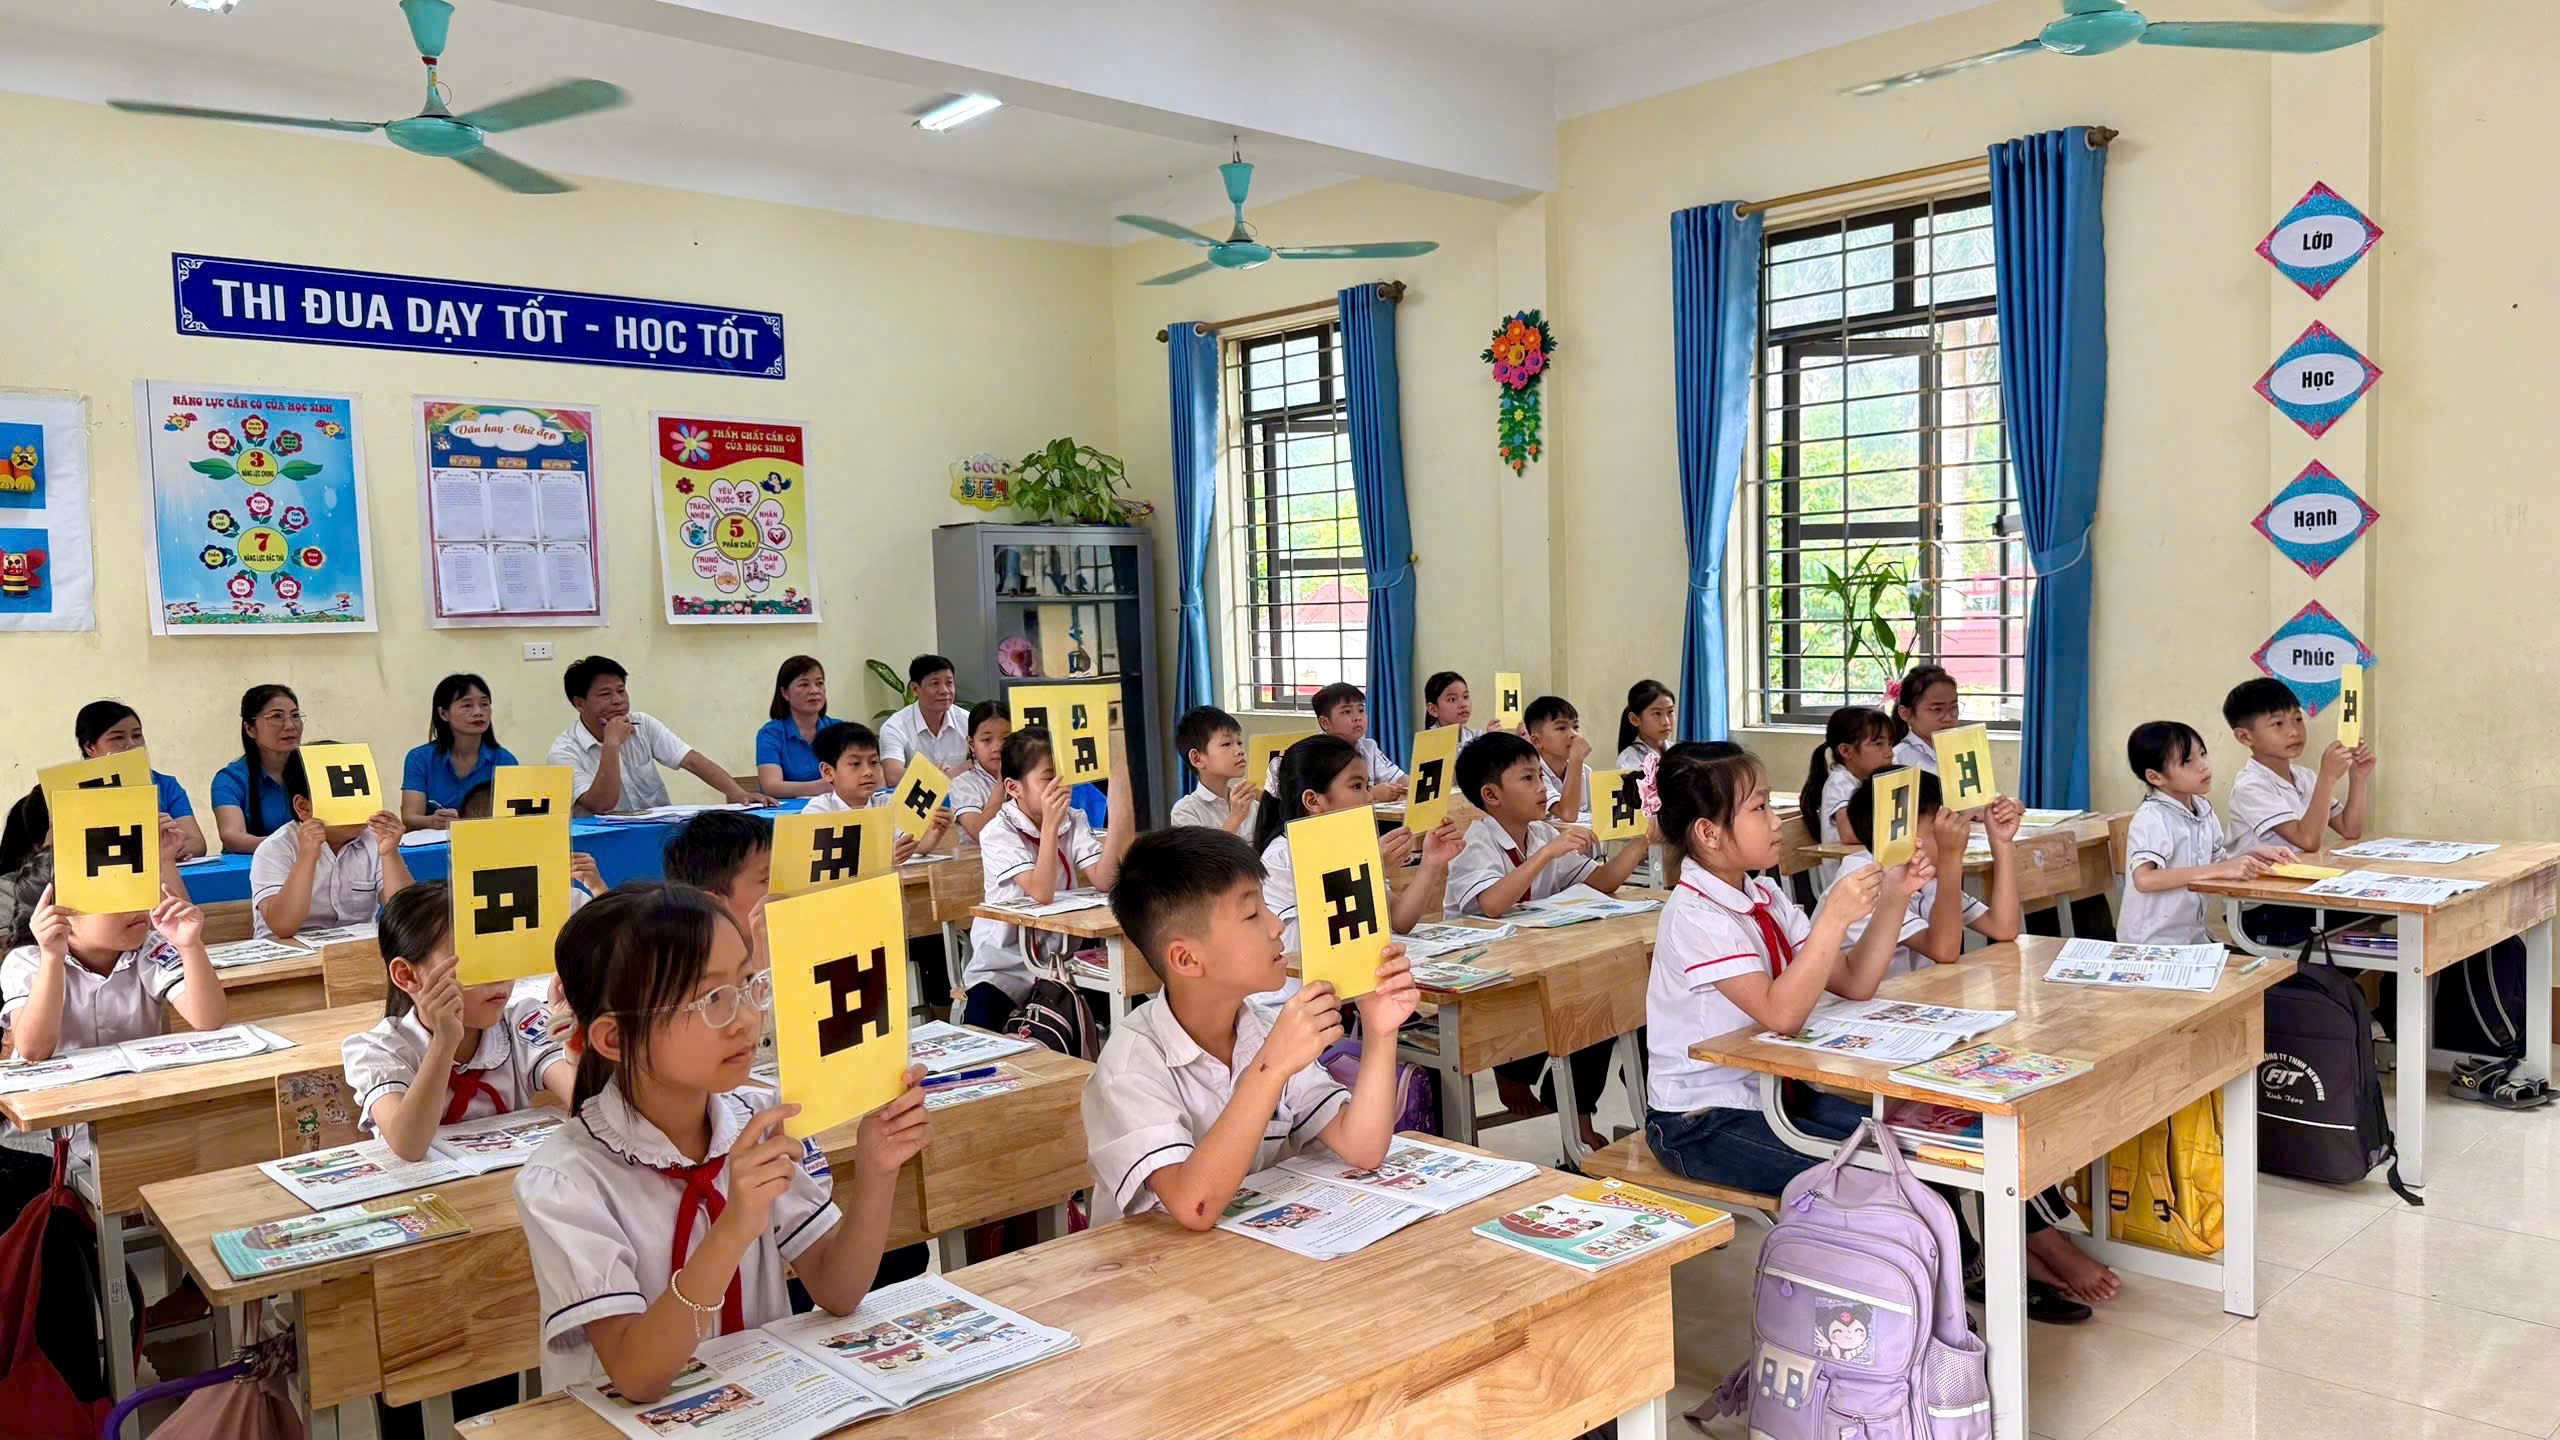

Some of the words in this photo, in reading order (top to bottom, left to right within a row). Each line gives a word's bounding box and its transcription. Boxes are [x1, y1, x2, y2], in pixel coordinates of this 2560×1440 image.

[2302, 230, 2333, 251] Lớp
[212, 279, 286, 322] THI
[301, 287, 394, 332] ĐUA
[406, 296, 483, 344] DẠY
[497, 295, 568, 344] TỐT
[615, 316, 687, 359] HỌC
[697, 315, 758, 360] TỐT
[2302, 371, 2334, 391] Học
[310, 402, 333, 413] SINH
[484, 423, 504, 433] hay
[745, 443, 763, 453] HỌC
[764, 444, 785, 453] SINH
[249, 451, 265, 468] 3
[718, 487, 732, 495] YÊU
[689, 502, 711, 510] TRÁCH
[716, 496, 735, 504] NƯỚC
[729, 518, 744, 538] 5
[2294, 509, 2337, 531] Hạnh
[254, 532, 271, 552] 7
[698, 565, 717, 573] THỰC
[2292, 647, 2335, 666] Phúc
[2265, 1068, 2304, 1085] FIT
